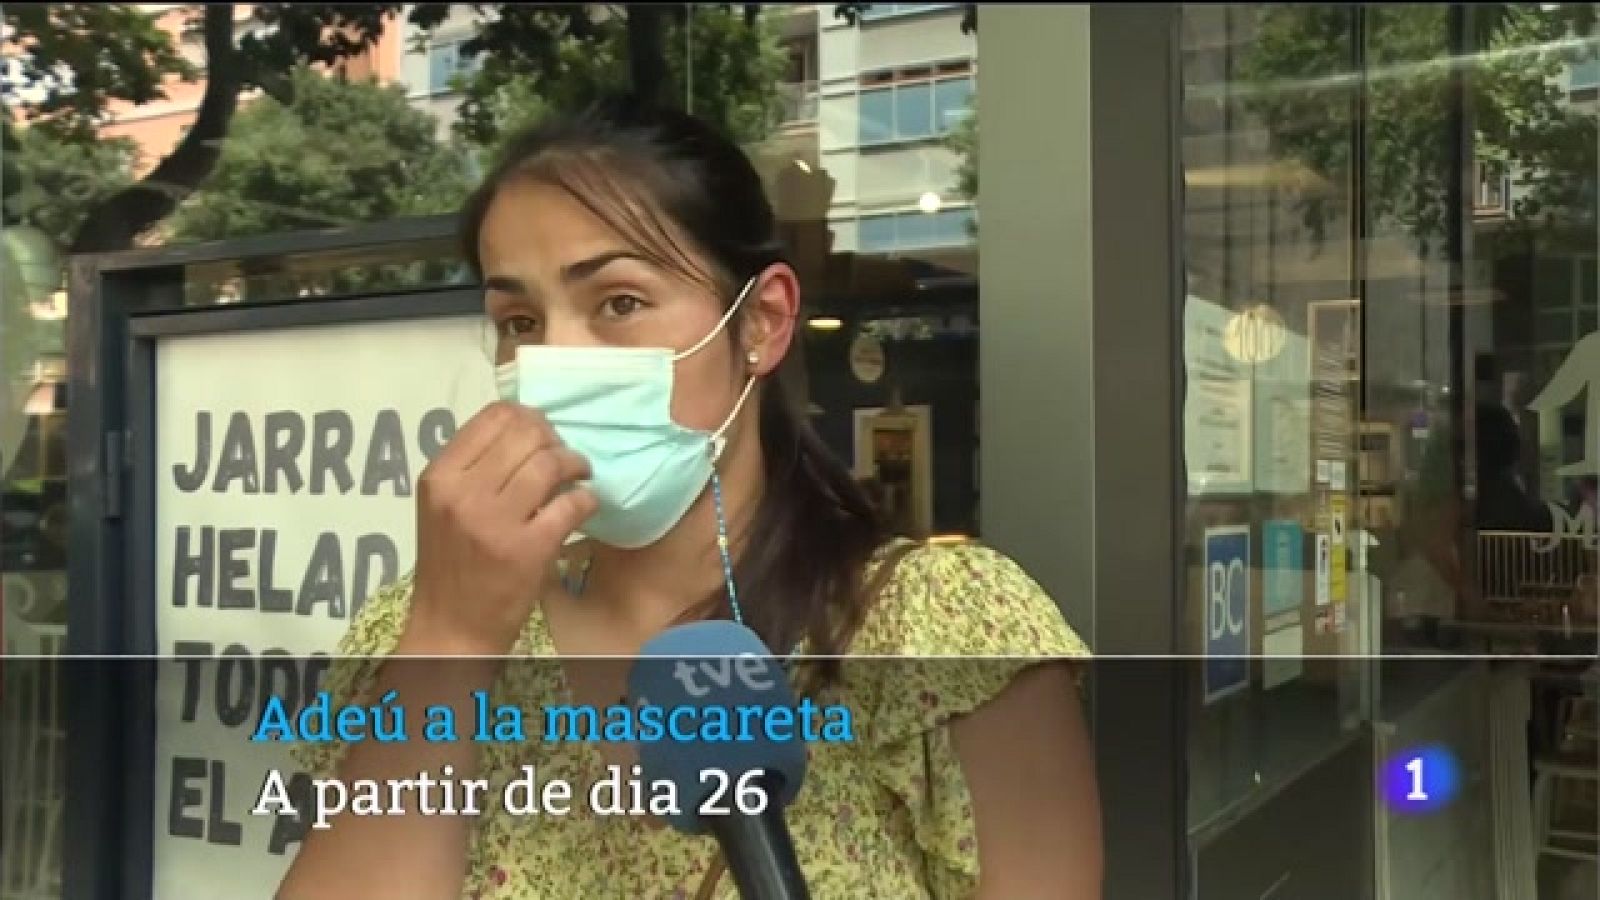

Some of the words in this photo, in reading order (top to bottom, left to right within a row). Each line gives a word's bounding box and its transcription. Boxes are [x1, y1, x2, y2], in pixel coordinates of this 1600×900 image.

[1209, 557, 1244, 641] BC
[673, 652, 775, 697] tve
[169, 756, 243, 846] EL
